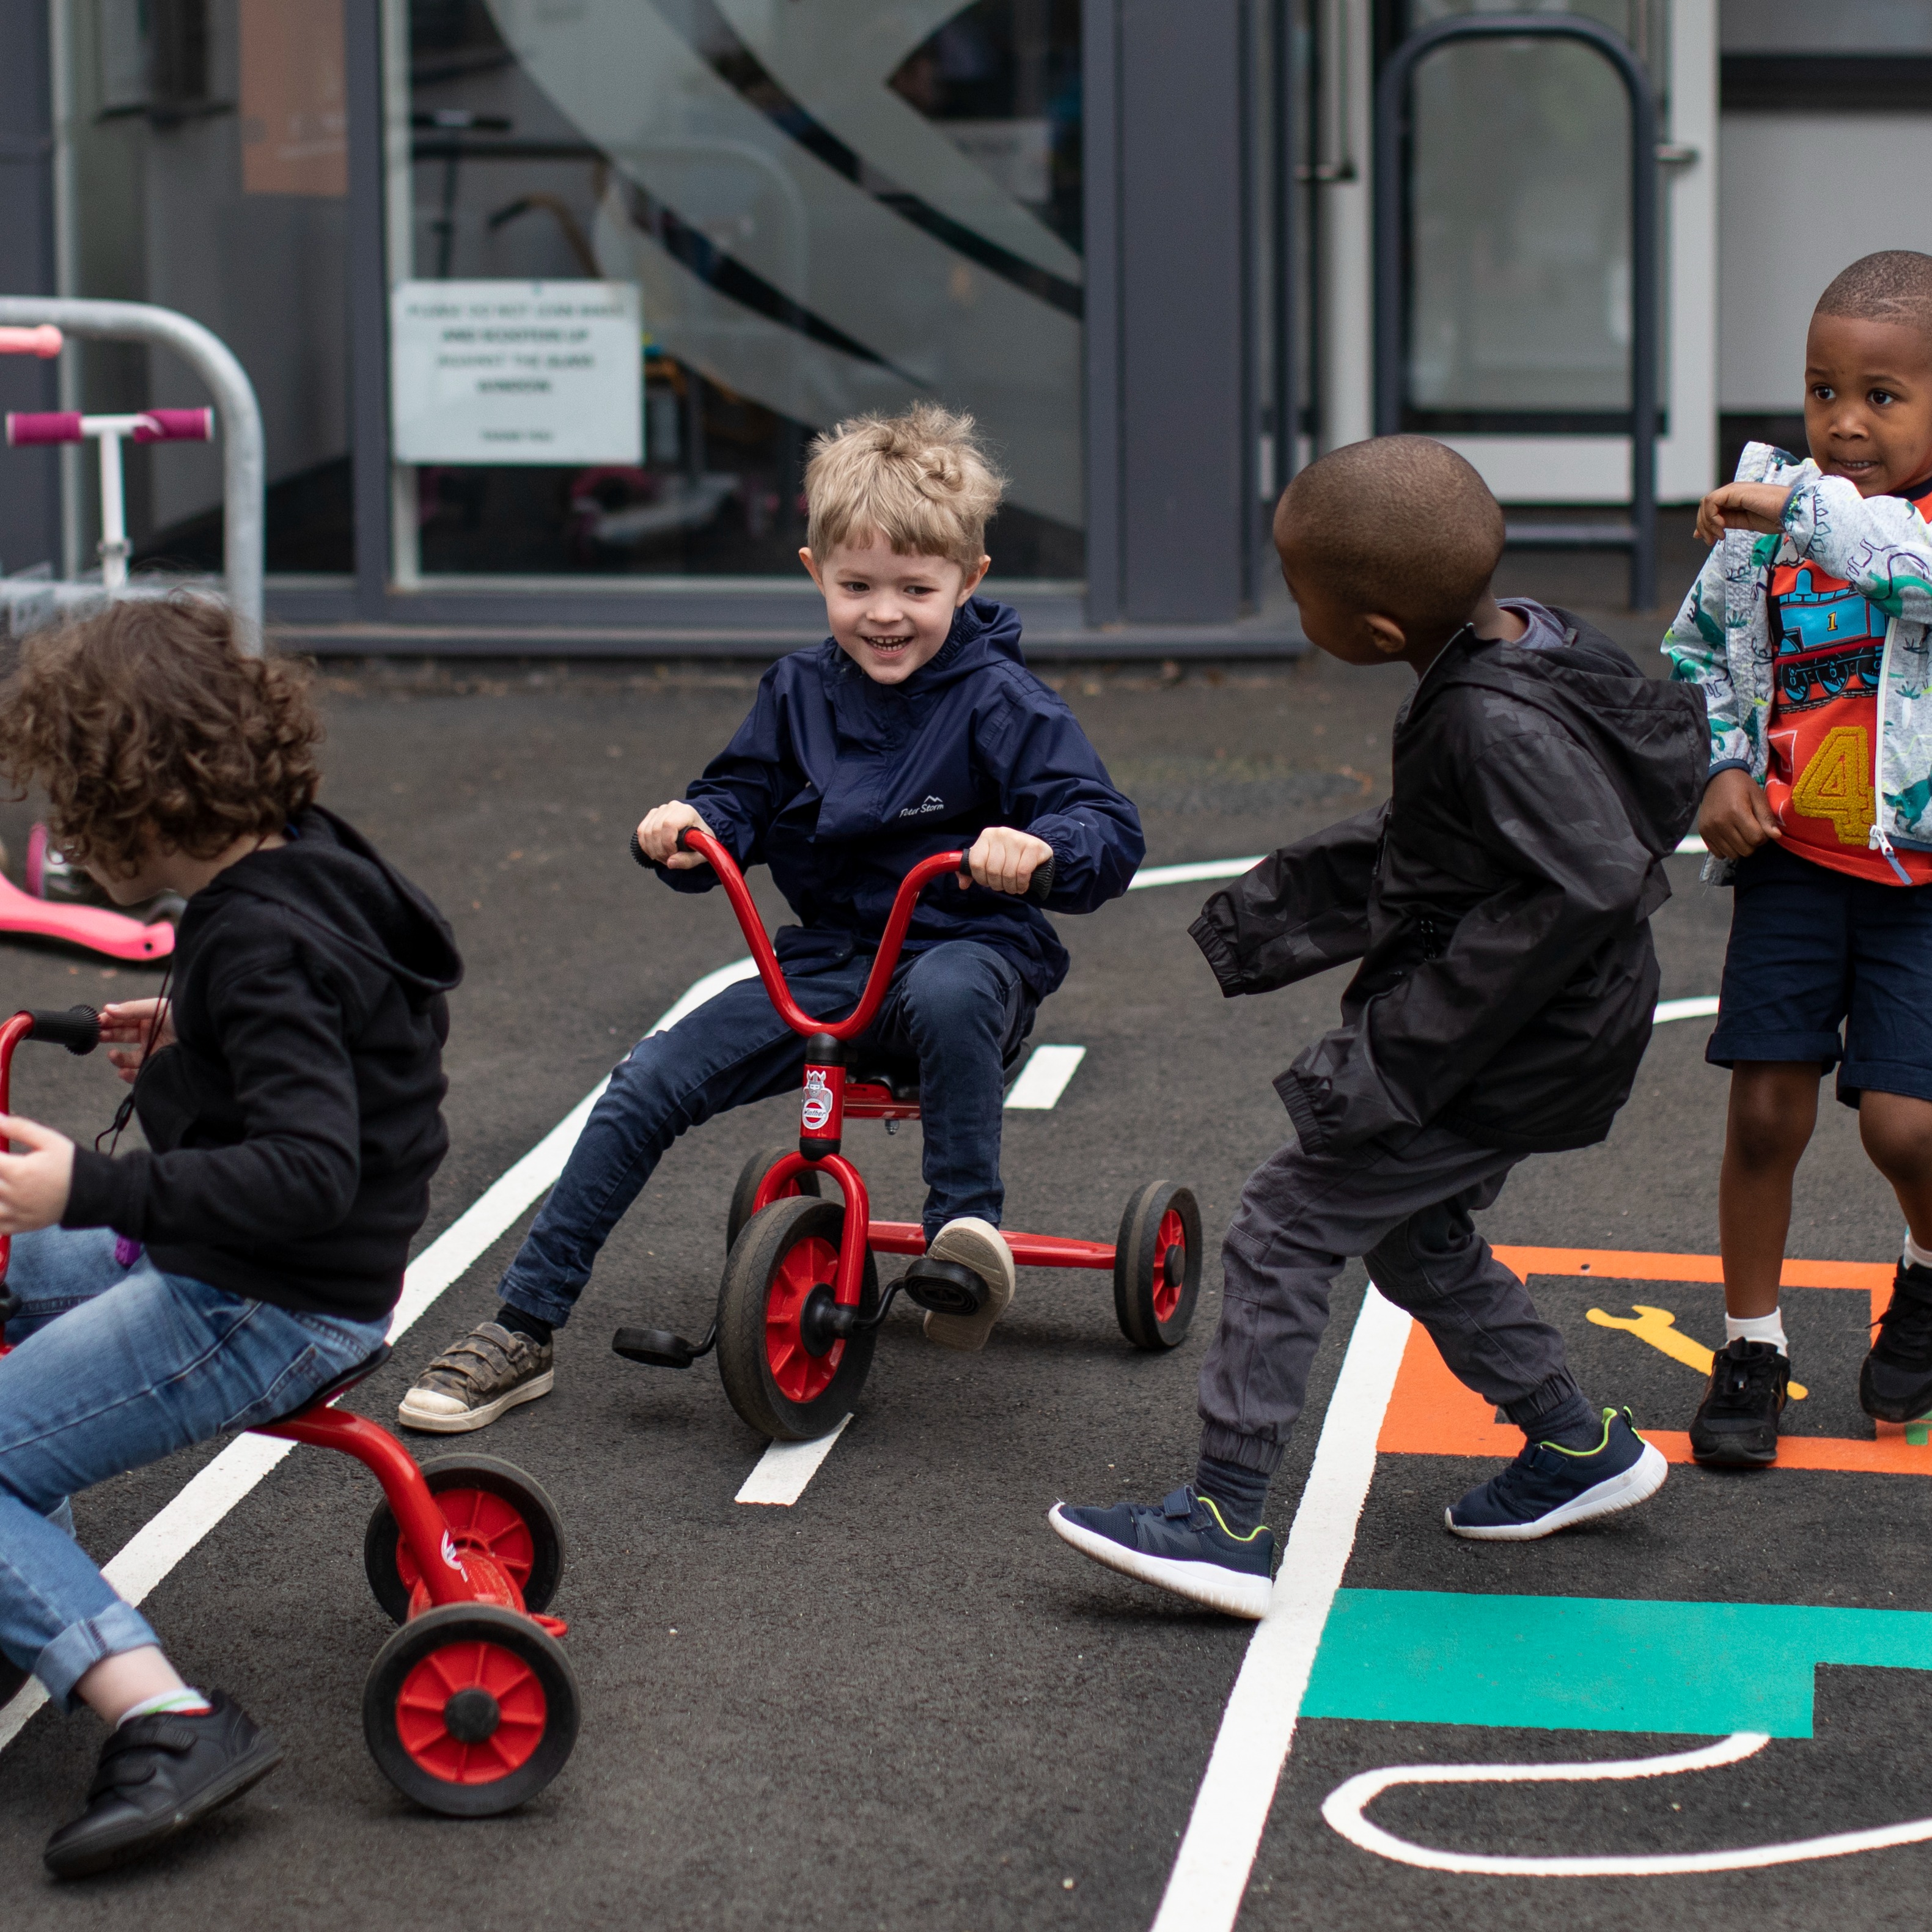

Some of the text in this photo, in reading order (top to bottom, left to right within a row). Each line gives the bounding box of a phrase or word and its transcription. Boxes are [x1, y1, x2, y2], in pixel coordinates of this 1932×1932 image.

[1827, 611, 1838, 632] 1
[1792, 725, 1875, 846] 4
[899, 804, 944, 818] Peter Storm
